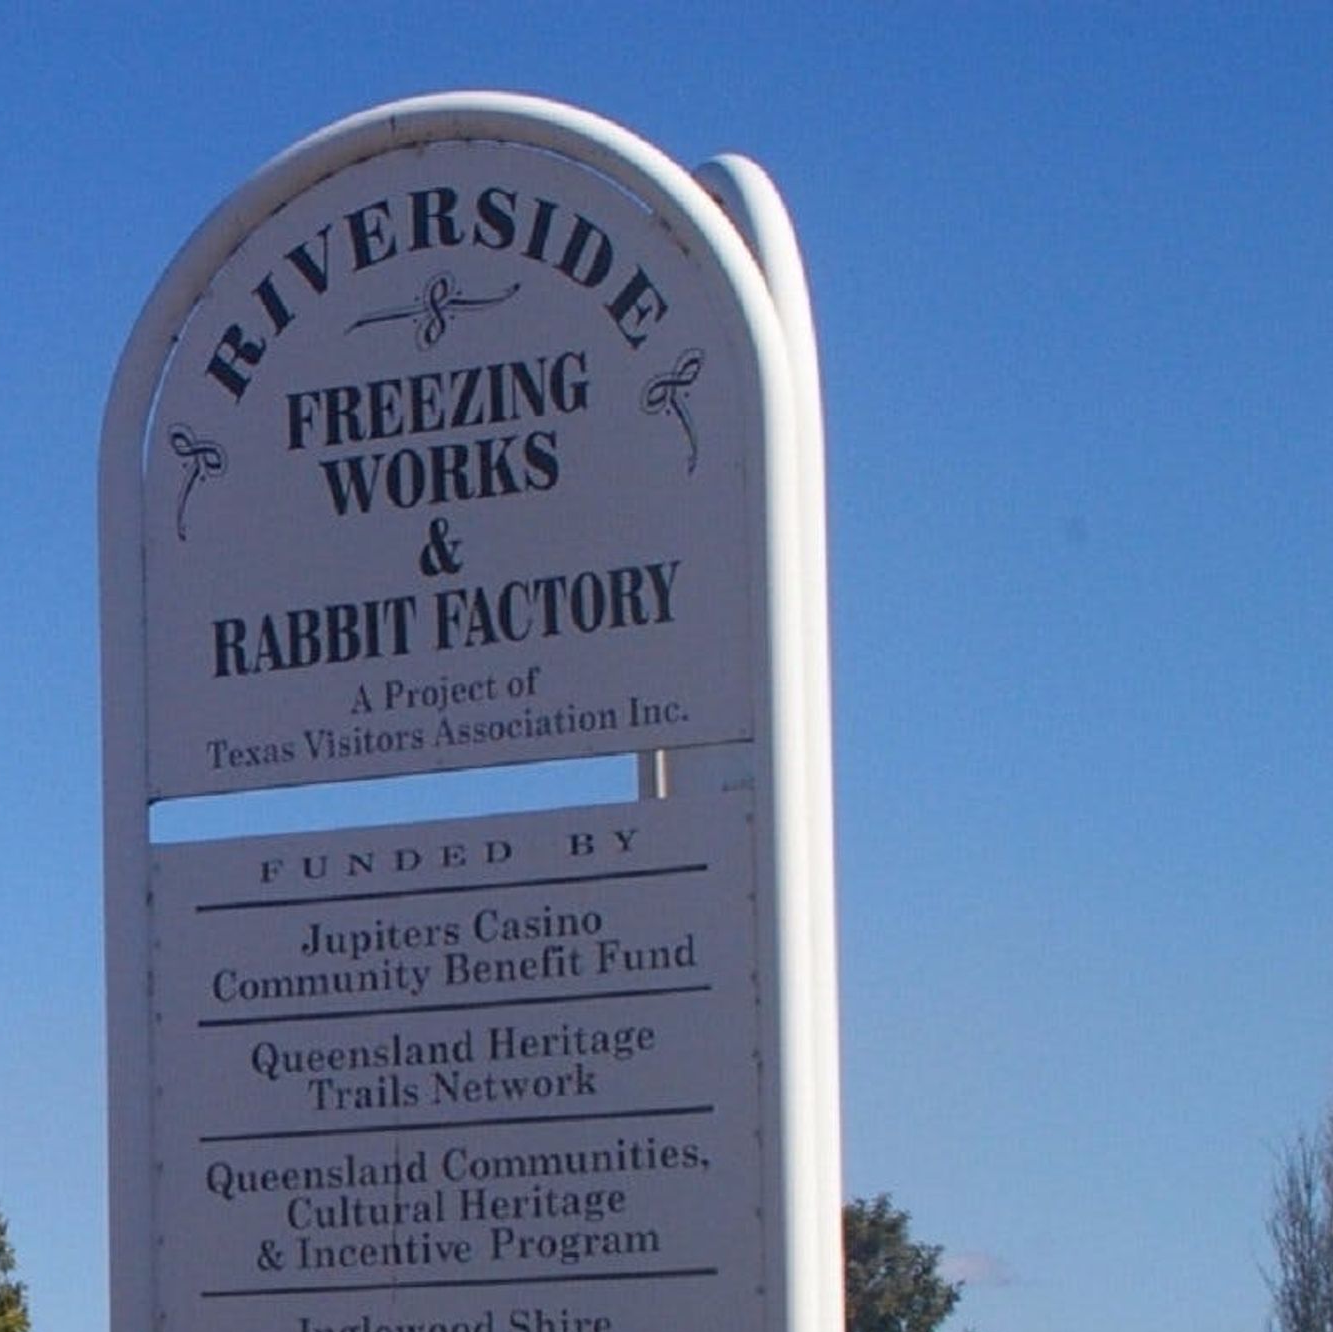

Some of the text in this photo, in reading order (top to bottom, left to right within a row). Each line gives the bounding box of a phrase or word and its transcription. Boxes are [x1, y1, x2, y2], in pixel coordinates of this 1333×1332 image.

[204, 185, 668, 404] RIVERSIDE
[287, 351, 591, 451] FREEZING
[320, 431, 559, 516] WORKS
[420, 518, 464, 577] &
[211, 560, 681, 679] RABBIT FACTORY
[351, 666, 541, 714] A Project of
[207, 696, 690, 769] Texas Visitors Association Inc.
[260, 829, 638, 882] FUNDED BY
[302, 906, 602, 960] Jupiters Casino
[212, 935, 696, 1002] Community Benefit Fund
[251, 1024, 655, 1080] Queensland Heritage
[308, 1065, 596, 1112] Trails Network
[206, 1138, 710, 1200] Queensland Communities,
[288, 1187, 626, 1232] Cultural Heritage
[256, 1228, 660, 1271] & Incentive Program
